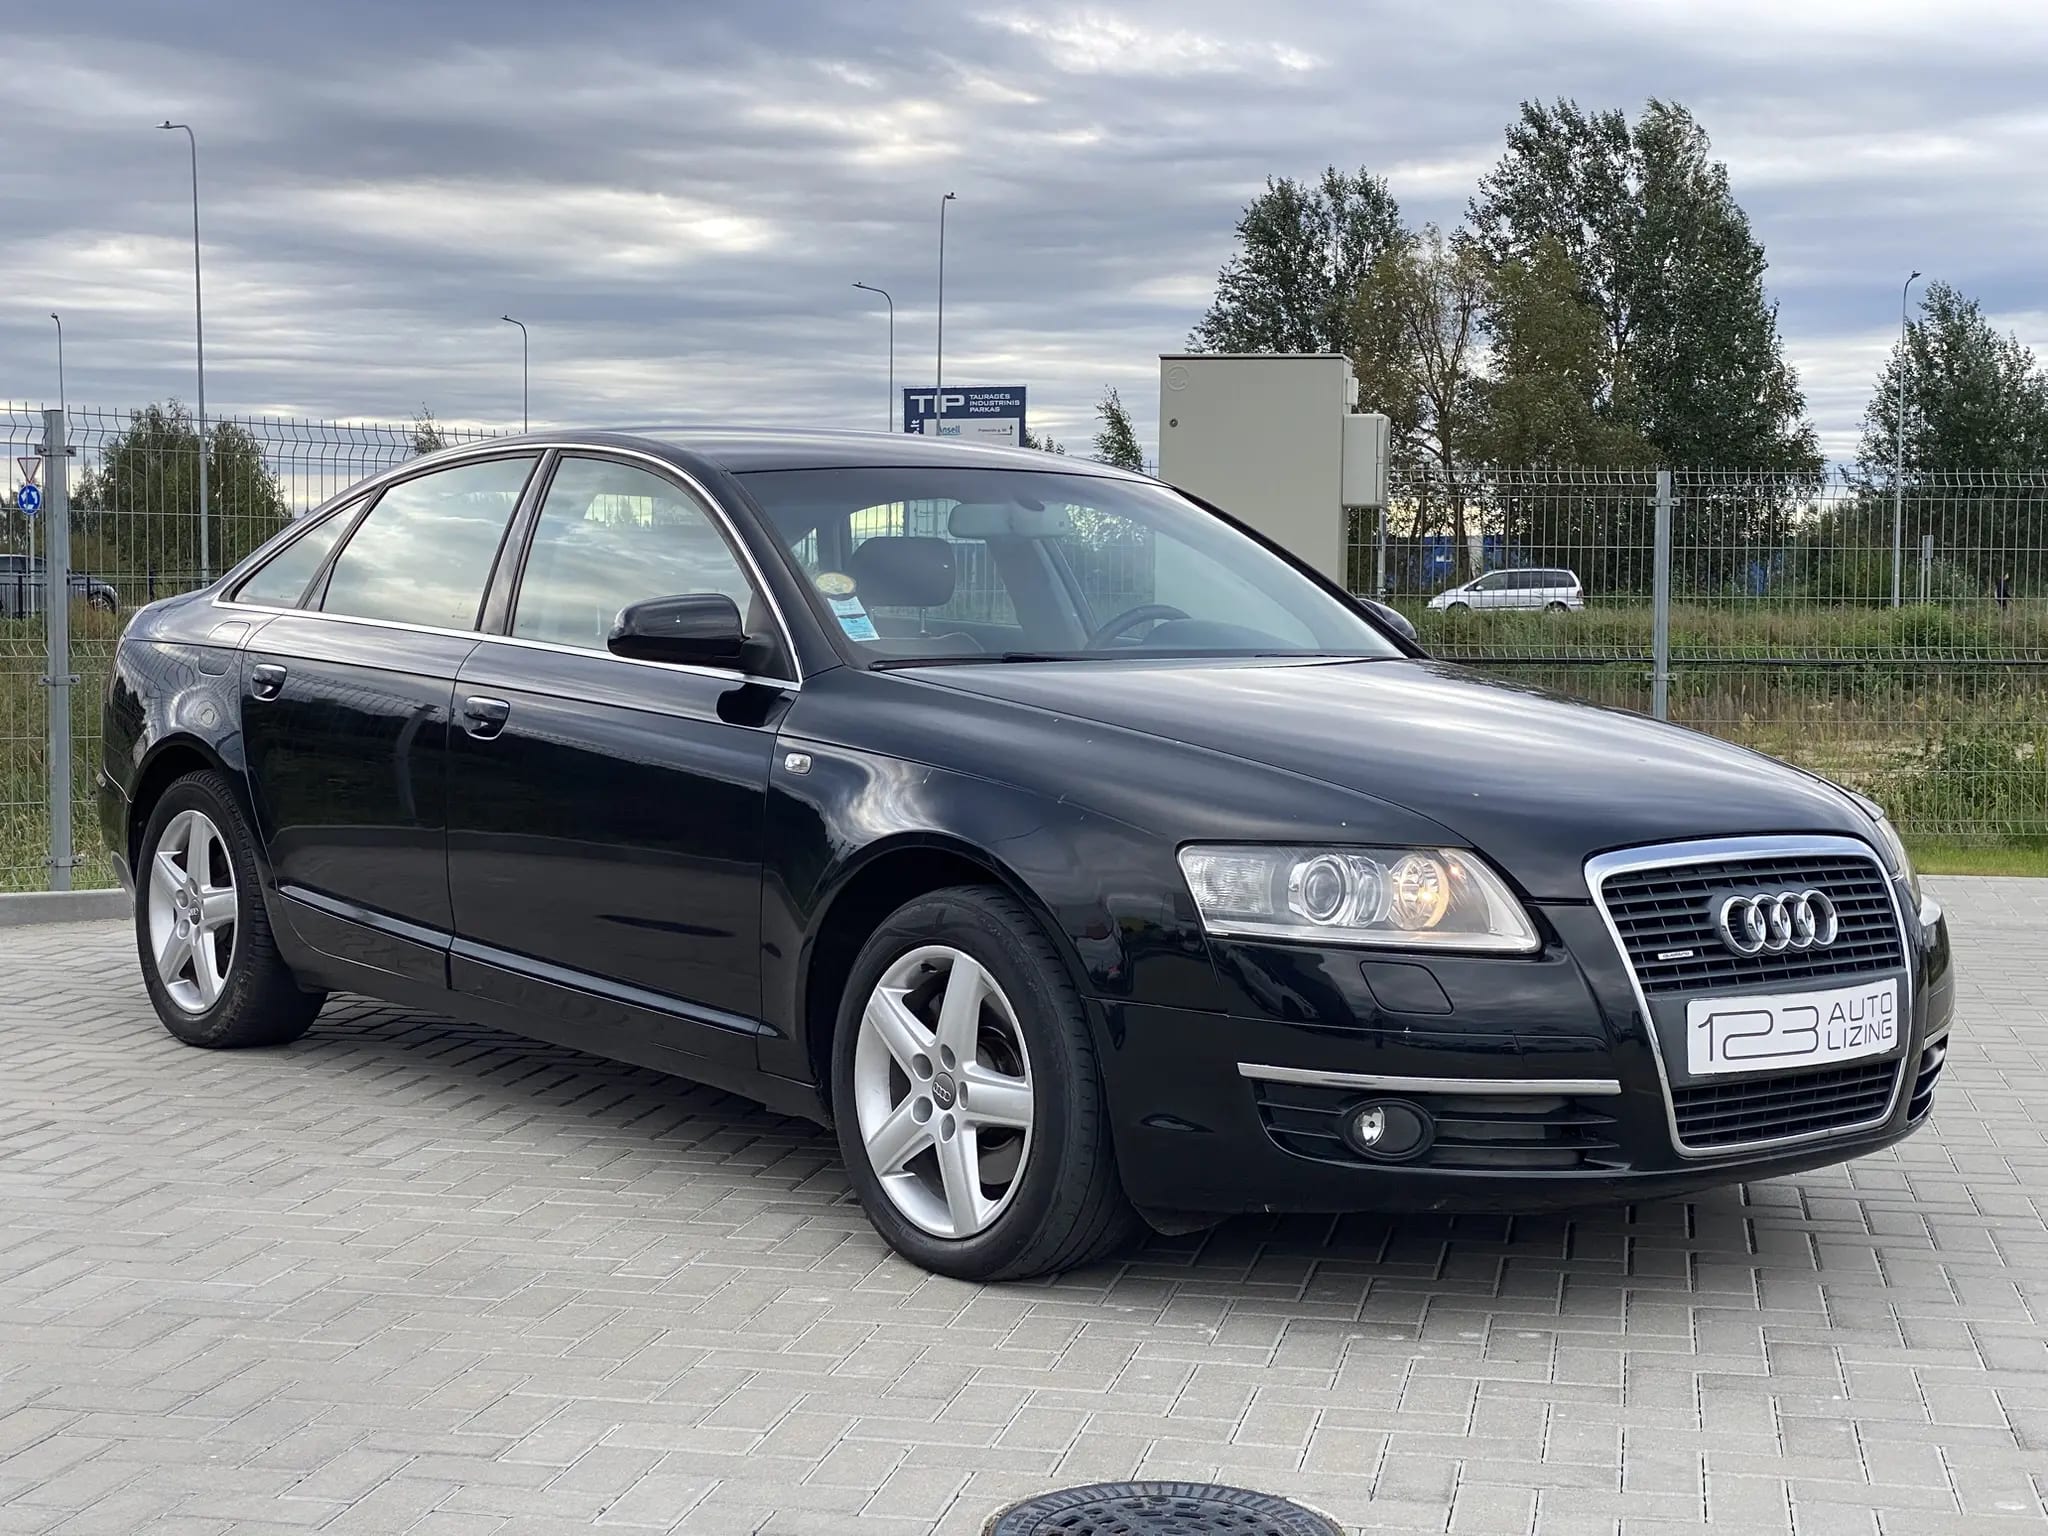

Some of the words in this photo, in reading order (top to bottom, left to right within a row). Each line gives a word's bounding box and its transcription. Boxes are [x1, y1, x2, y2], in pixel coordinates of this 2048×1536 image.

[910, 394, 965, 413] TIP
[1827, 991, 1893, 1026] AUTO
[1698, 1005, 1819, 1062] 123
[1827, 1018, 1892, 1050] LIZING
